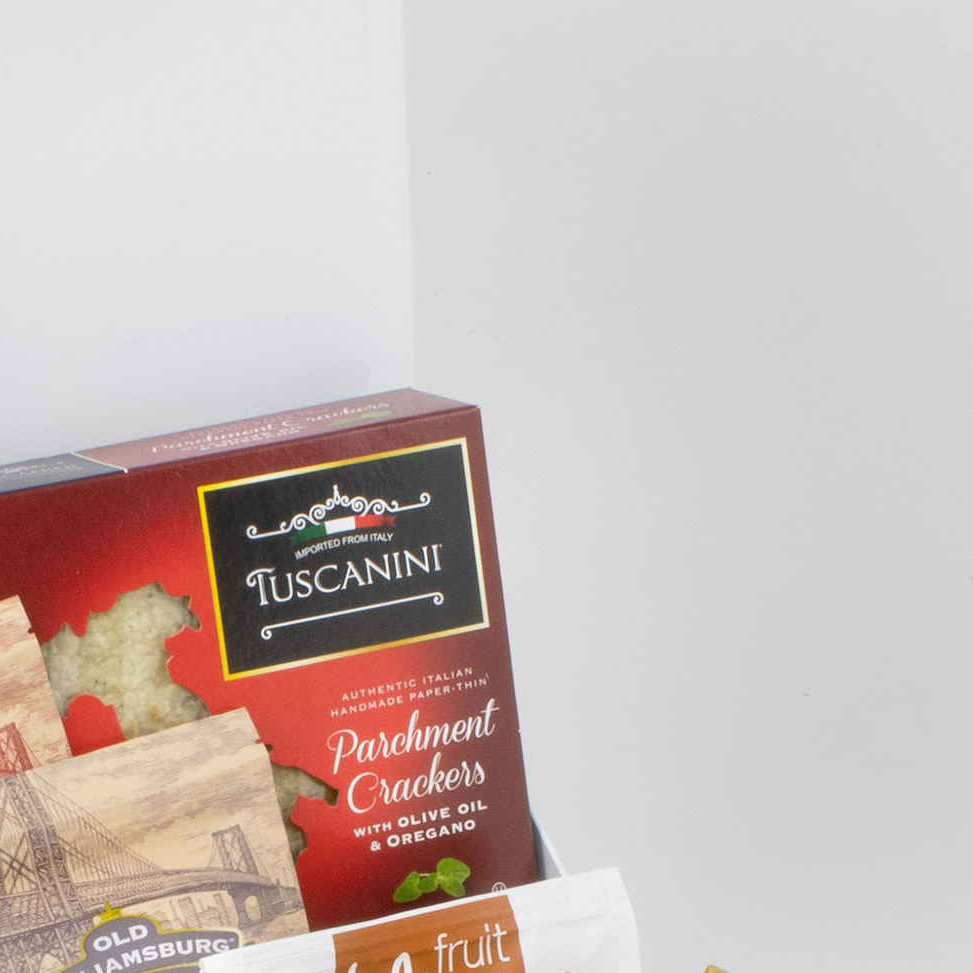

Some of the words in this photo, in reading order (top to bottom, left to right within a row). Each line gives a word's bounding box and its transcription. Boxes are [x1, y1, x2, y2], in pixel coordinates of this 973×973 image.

[295, 537, 341, 559] IMPORTED
[342, 533, 368, 546] FROM
[369, 532, 394, 542] ITALY
[246, 544, 442, 606] TUSCANINI
[330, 695, 404, 717] HANDMADE
[409, 677, 486, 701] PAPER-THIN
[342, 678, 417, 701] AUTHENTIC
[422, 667, 473, 684] ITALIAN
[327, 698, 500, 775] Parchment
[347, 752, 485, 814] Crackers
[354, 821, 392, 838] WITH
[397, 807, 451, 828] OLIVE
[457, 800, 487, 814] OIL
[370, 841, 382, 851] &
[386, 819, 476, 847] OREGANO
[93, 924, 149, 952] OLD
